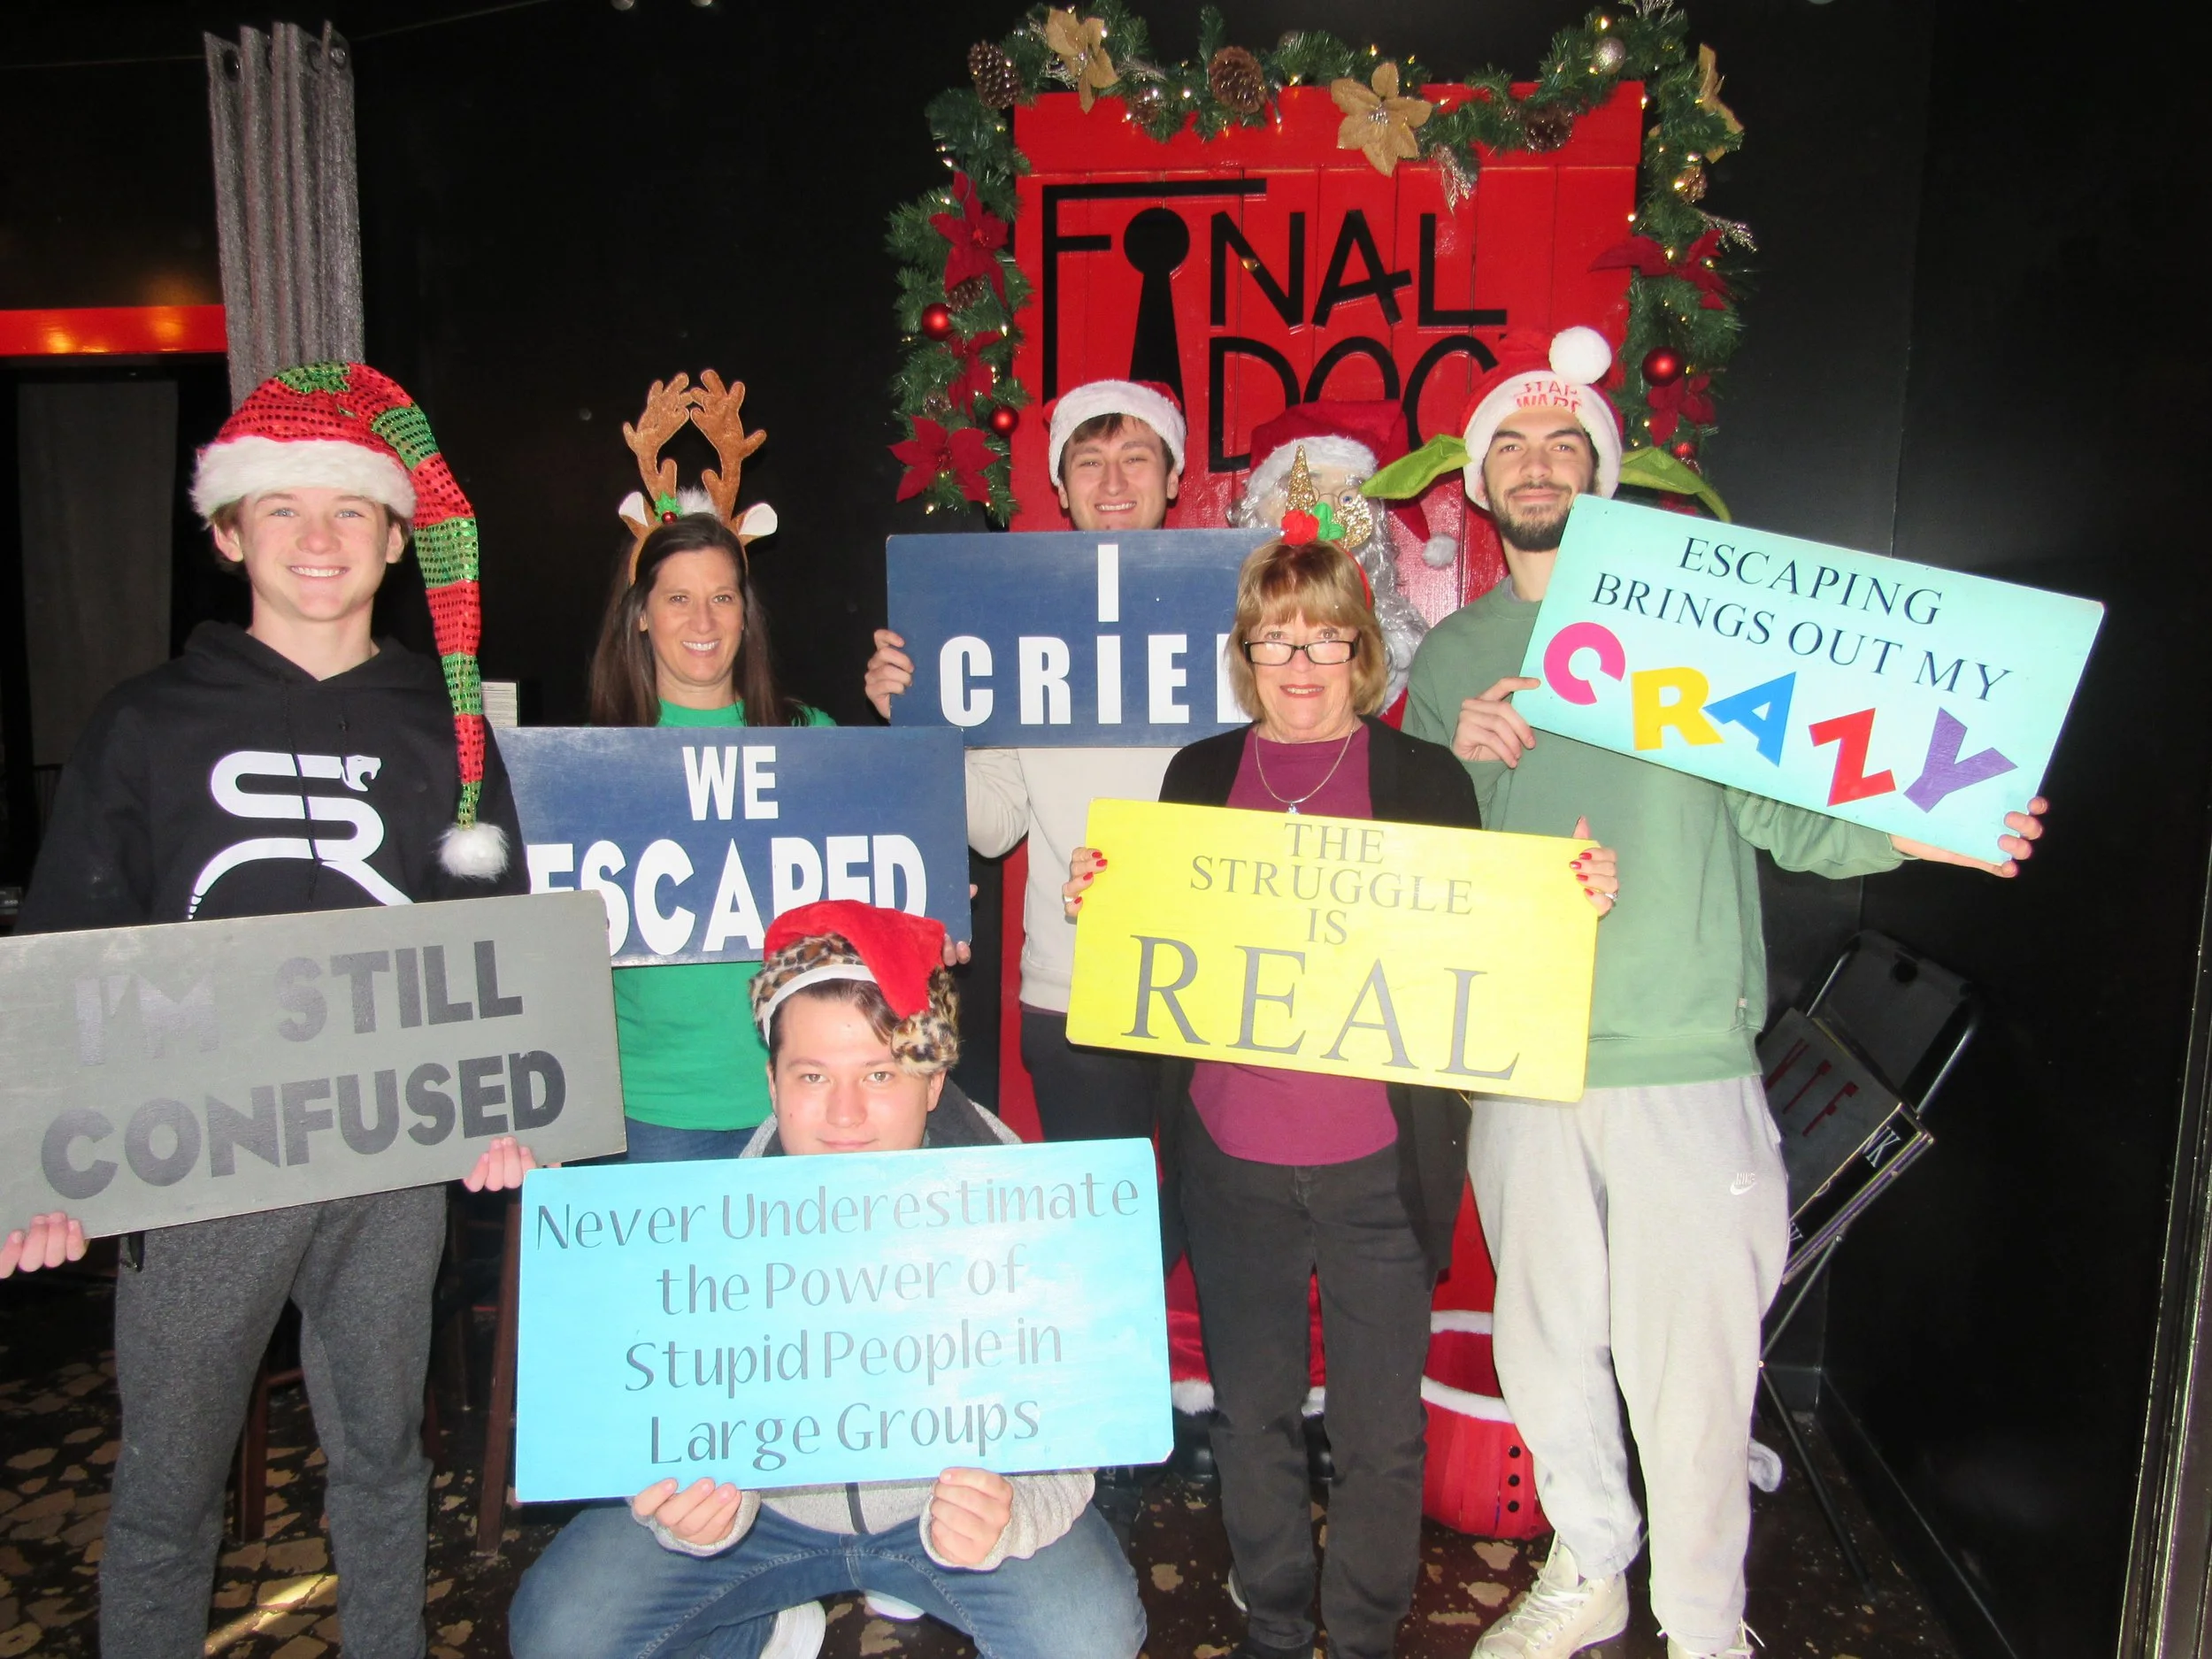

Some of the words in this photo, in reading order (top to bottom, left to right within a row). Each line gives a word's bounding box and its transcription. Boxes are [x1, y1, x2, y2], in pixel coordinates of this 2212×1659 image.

[1097, 543, 1118, 623] I
[1678, 536, 1943, 625] ESCAPING
[1590, 572, 1772, 645] BRINGS
[1787, 621, 1903, 675] OUT
[1913, 650, 2014, 703] MY
[1543, 621, 2018, 813] CRAZY
[682, 746, 780, 821] WE
[1284, 822, 1386, 864] THE
[1190, 855, 1473, 916] STRUGGLE
[1307, 909, 1348, 946] IS
[74, 972, 220, 1067] I'M
[276, 940, 524, 1043] STILL
[1120, 934, 1521, 1081] REAL
[41, 1049, 566, 1200] CONFUSED
[536, 1203, 707, 1251] Never
[722, 1172, 1141, 1240] Underestimate
[657, 1264, 750, 1316] the
[765, 1258, 951, 1310] Power
[967, 1244, 1026, 1296] of
[624, 1329, 809, 1399] Stupid
[824, 1318, 1003, 1386] People
[1017, 1317, 1063, 1364] in
[651, 1413, 821, 1471] Large
[837, 1397, 1041, 1457] Groups
